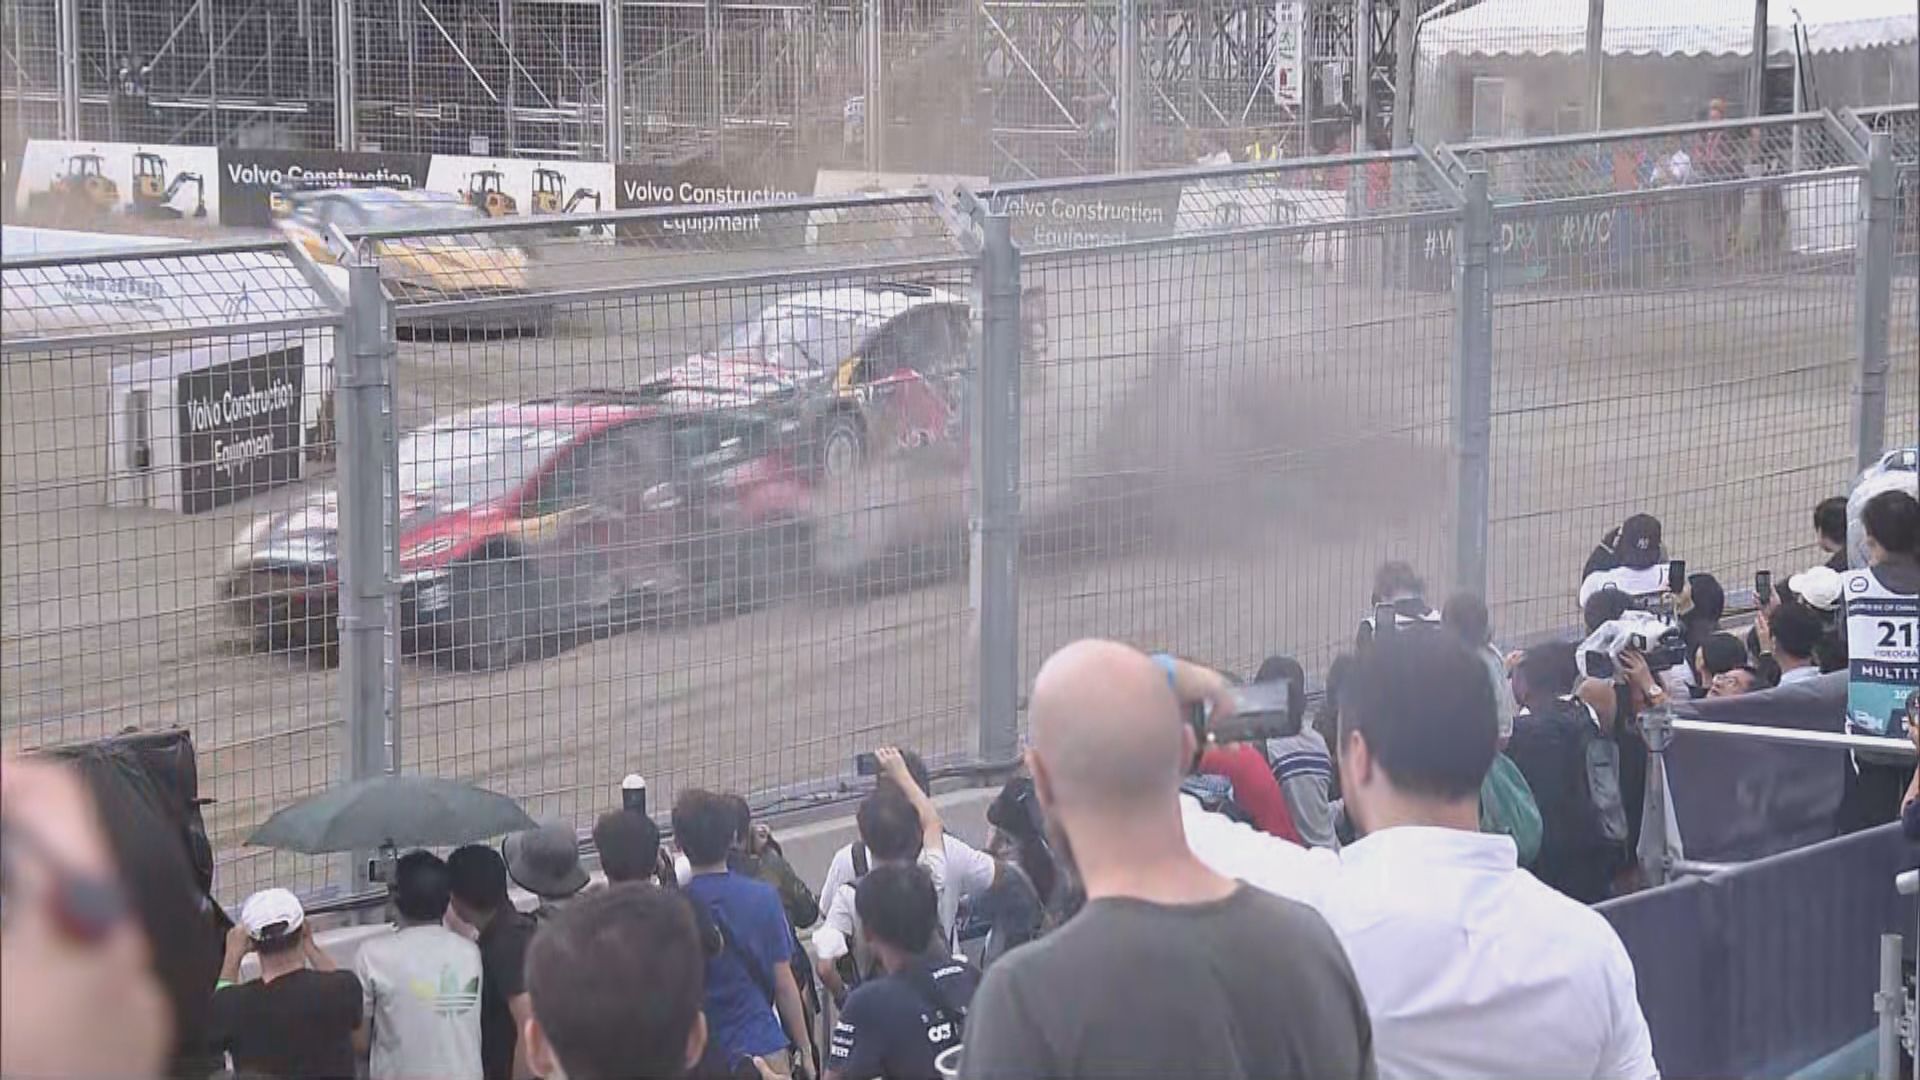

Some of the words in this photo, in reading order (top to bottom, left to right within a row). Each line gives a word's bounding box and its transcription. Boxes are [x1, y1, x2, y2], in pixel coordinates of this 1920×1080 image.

[228, 163, 282, 184] Volvo
[288, 165, 413, 188] Construction
[624, 180, 674, 201] Volvo
[679, 182, 798, 204] Construction
[998, 194, 1046, 217] Volvo
[1051, 198, 1164, 223] Construction
[1033, 226, 1128, 247] Equipment
[187, 396, 221, 431] Volvo
[222, 378, 294, 423] Construction
[214, 433, 275, 477] Equipment
[1878, 621, 1918, 647] 21
[1862, 665, 1918, 679] MULTIT
